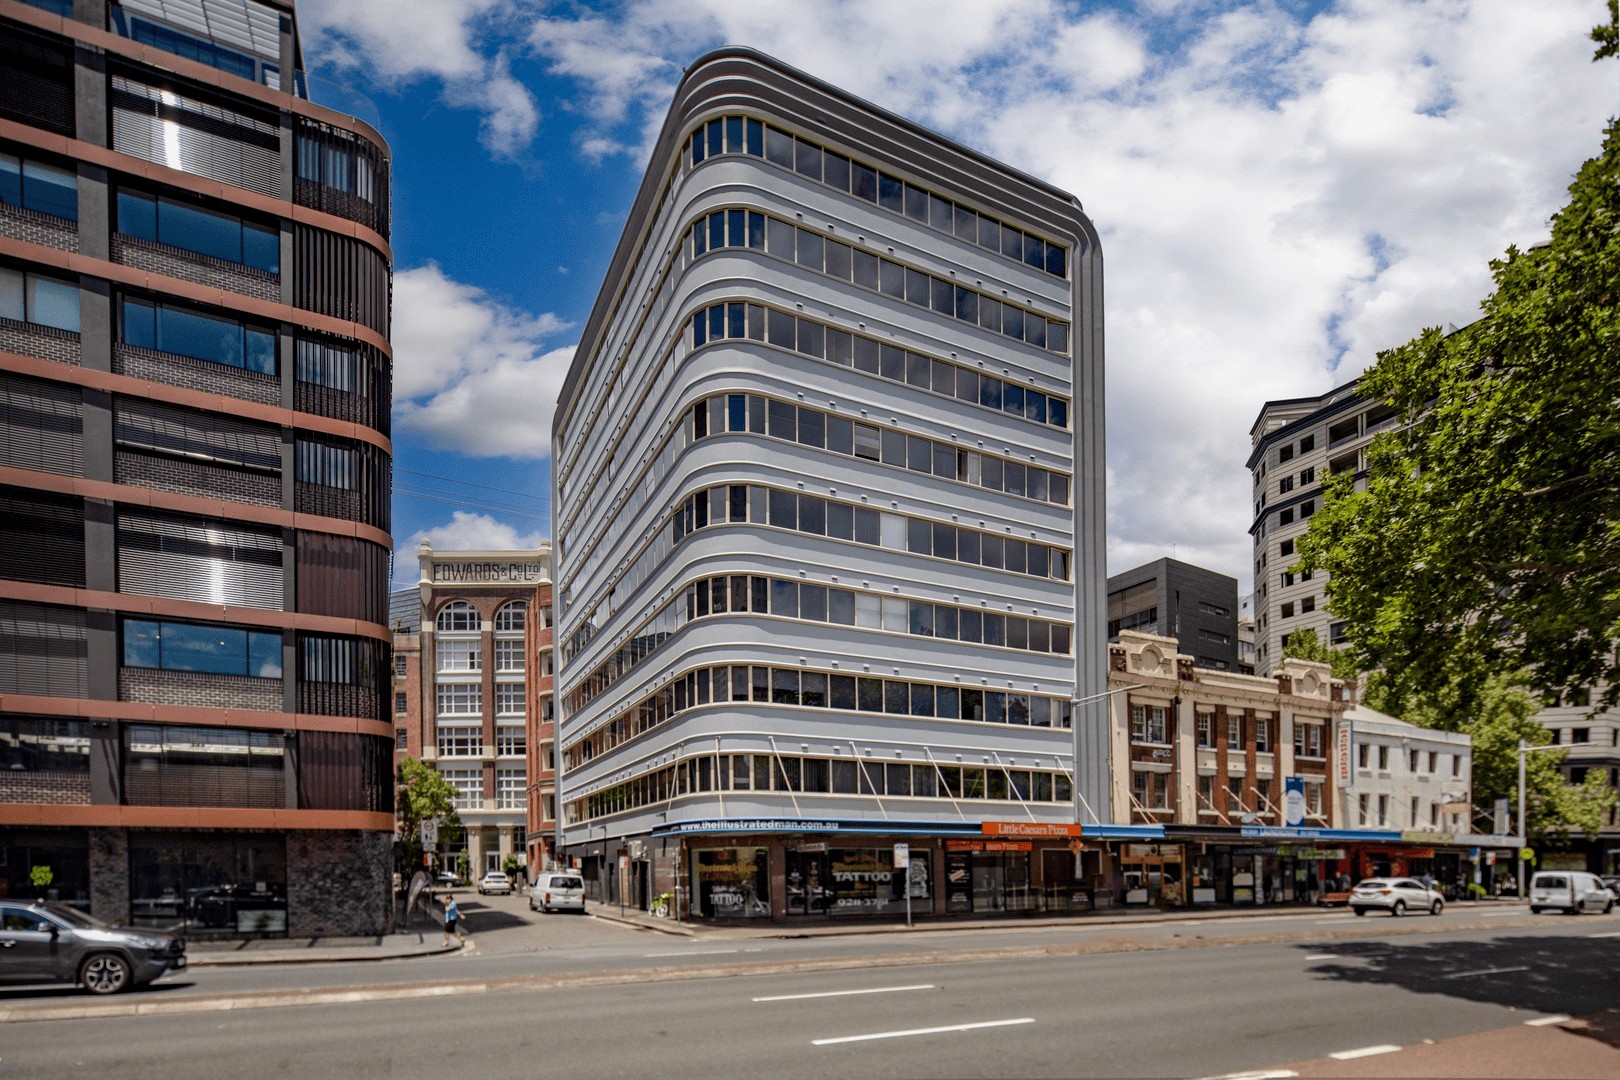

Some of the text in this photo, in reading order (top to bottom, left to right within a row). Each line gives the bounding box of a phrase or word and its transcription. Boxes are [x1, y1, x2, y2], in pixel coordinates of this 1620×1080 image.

[433, 563, 500, 581] EDWARDS
[501, 566, 507, 577] &
[680, 820, 839, 831] www.theillustratedman.com.au
[998, 823, 1068, 835] Little Caesars Pizza
[832, 871, 891, 882] TATTOO
